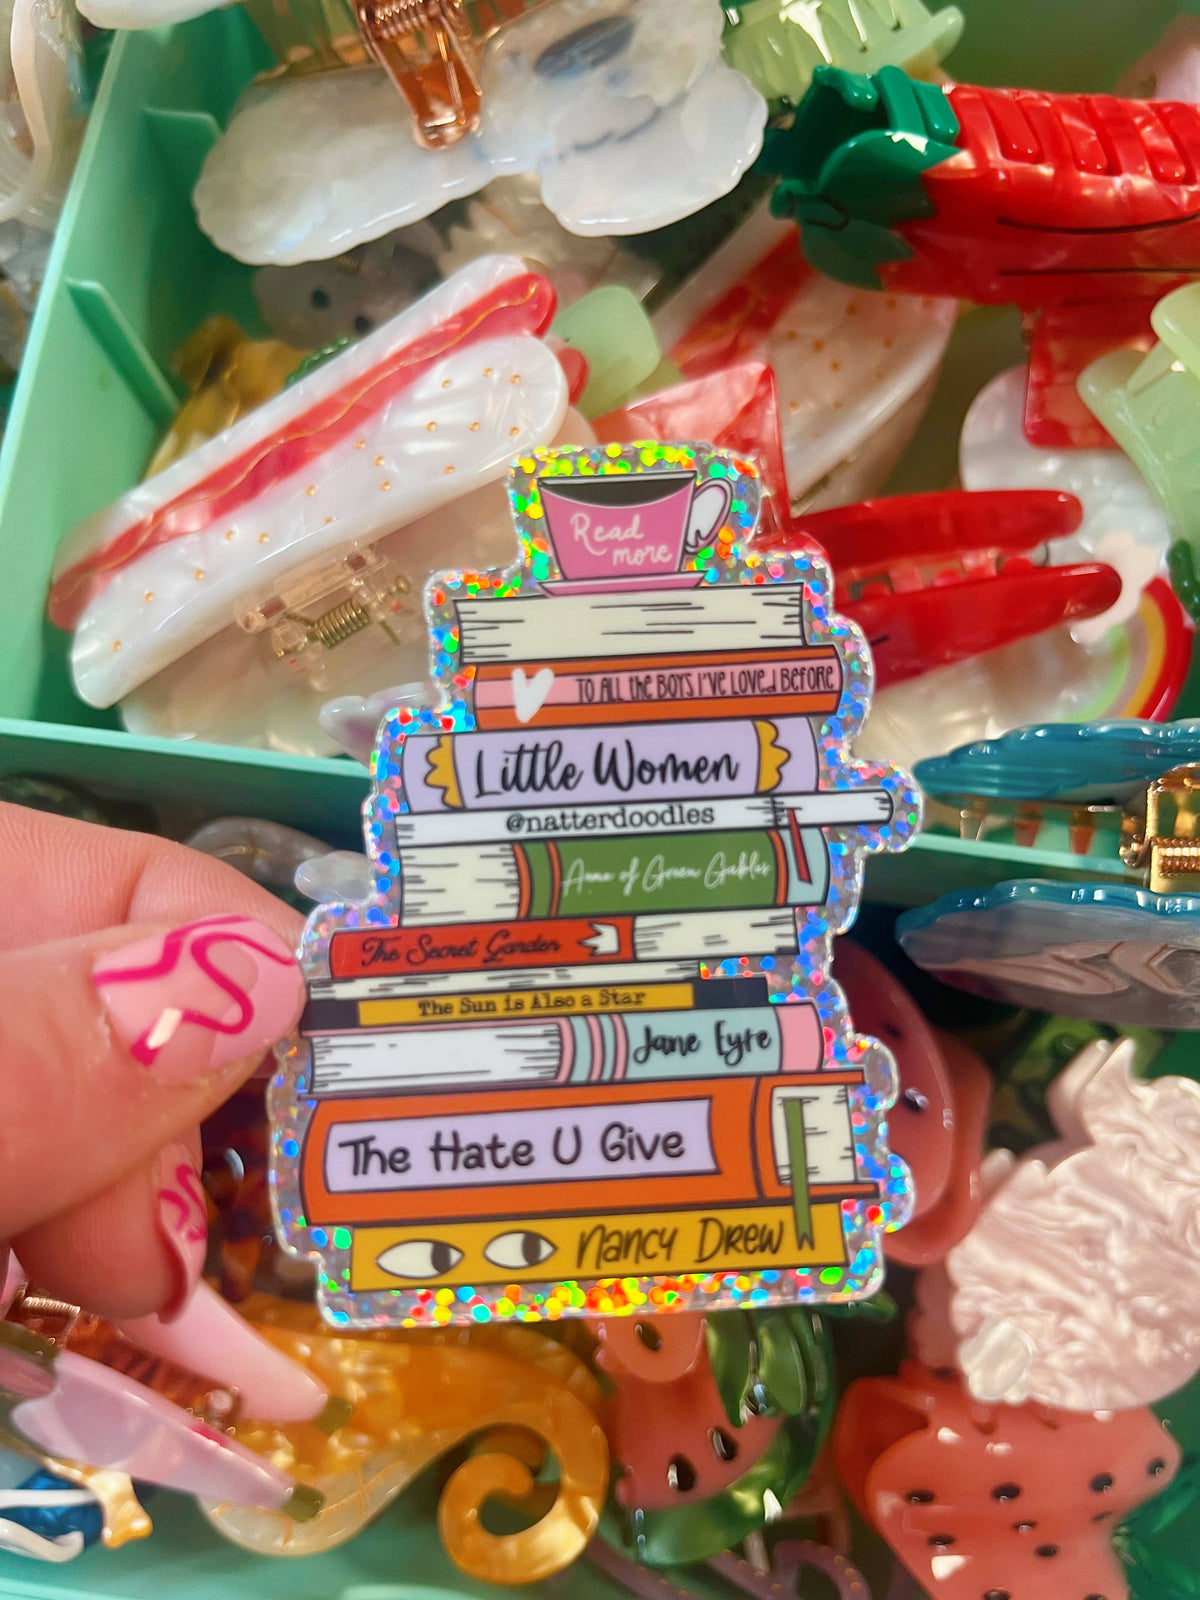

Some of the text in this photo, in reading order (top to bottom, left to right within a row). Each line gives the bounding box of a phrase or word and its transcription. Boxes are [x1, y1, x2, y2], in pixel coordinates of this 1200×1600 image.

[569, 512, 644, 556] Read
[612, 544, 673, 566] more
[577, 678, 595, 703] TO
[601, 677, 624, 700] ALL
[656, 673, 692, 698] BOYS
[475, 739, 740, 799] Little Women
[506, 806, 715, 833] @natterdoodles
[618, 856, 640, 897] of
[641, 854, 702, 892] Green
[704, 851, 771, 889] Gables
[361, 929, 561, 966] The Secret Garden
[418, 1000, 454, 1016] The
[460, 997, 497, 1013] Sun
[532, 991, 576, 1008] Also
[582, 995, 592, 1006] a
[600, 988, 646, 1006] Star
[633, 1020, 772, 1067] Jane Eyre
[338, 1122, 685, 1176] The Hate U Give
